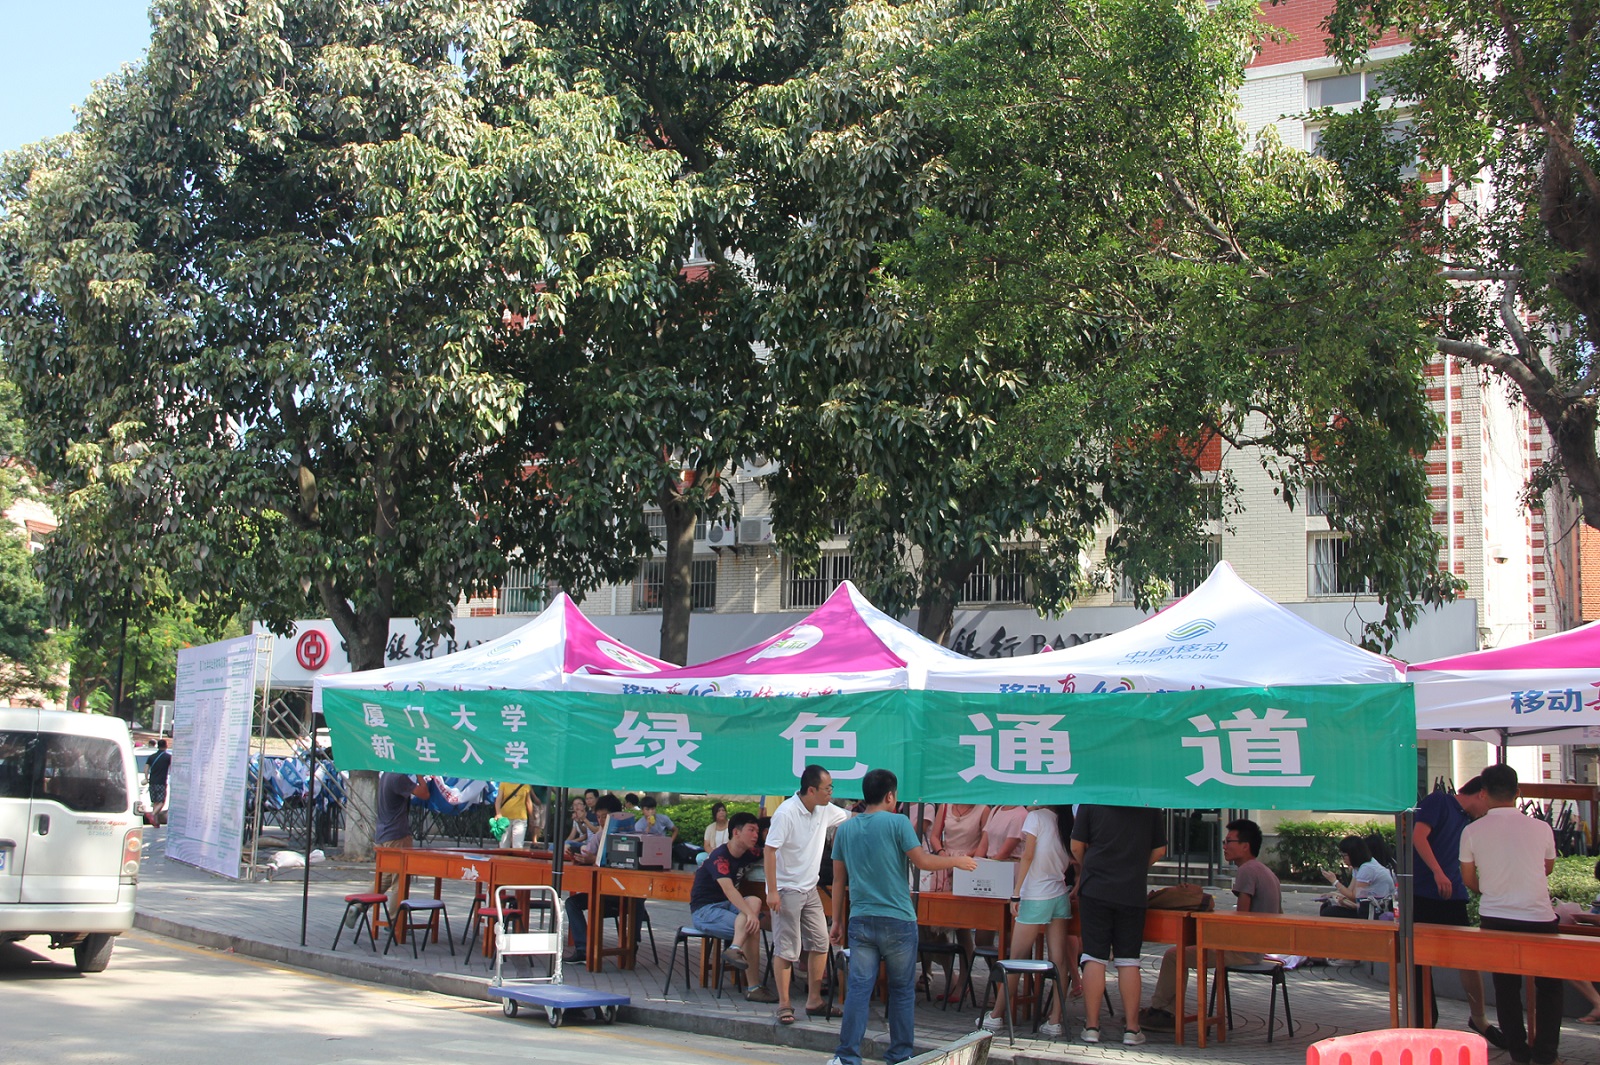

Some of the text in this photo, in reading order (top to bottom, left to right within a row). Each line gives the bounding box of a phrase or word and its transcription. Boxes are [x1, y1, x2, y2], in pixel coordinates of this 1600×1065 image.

[1116, 656, 1161, 666] China
[1125, 641, 1229, 659] 中国移动
[362, 702, 527, 732] 厦门大学
[371, 734, 529, 769] 新生入学
[611, 708, 1315, 788] 绿色通道
